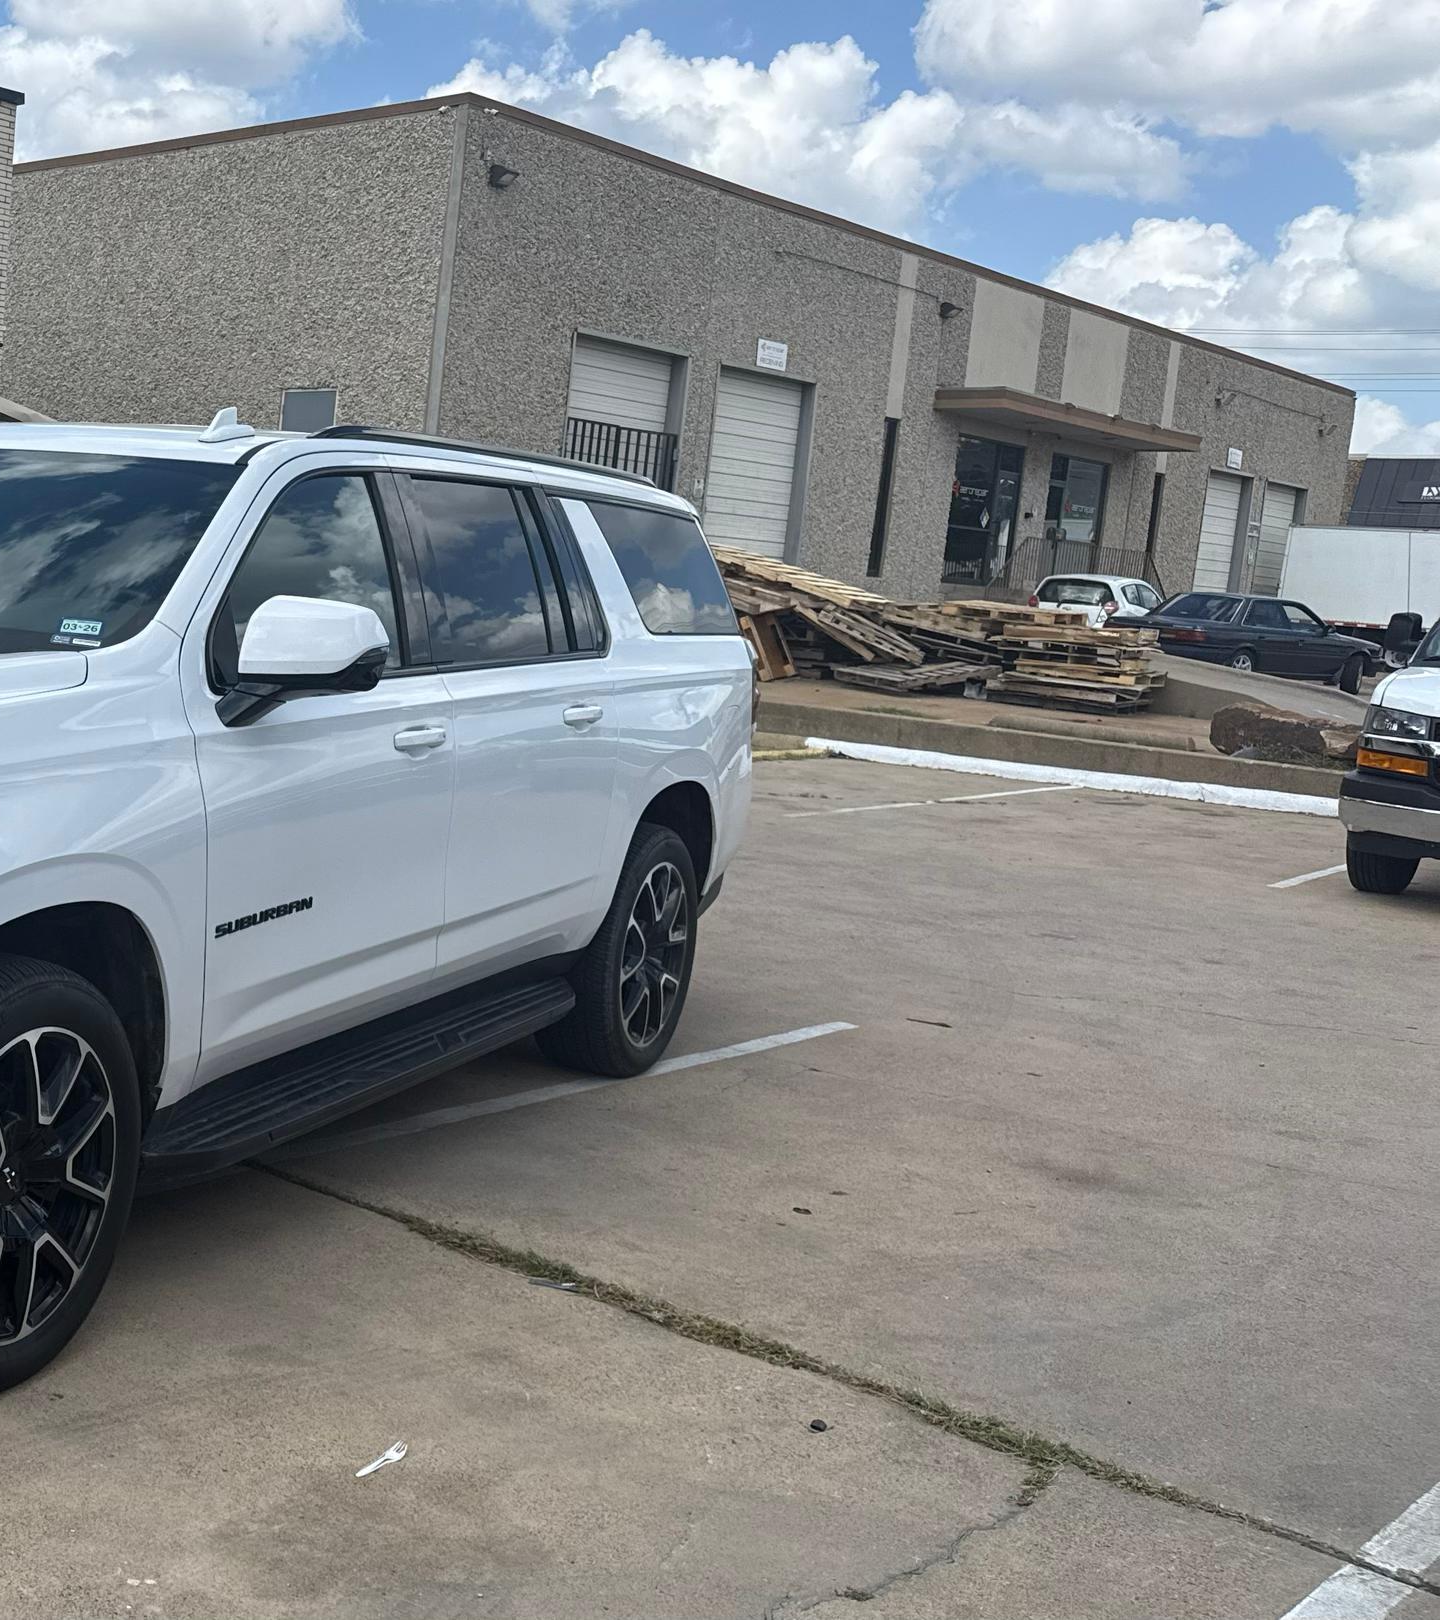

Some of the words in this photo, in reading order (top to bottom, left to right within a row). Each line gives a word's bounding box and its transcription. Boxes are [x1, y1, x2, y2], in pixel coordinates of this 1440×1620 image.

[63, 622, 77, 630] 03
[83, 624, 98, 632] 26
[215, 896, 313, 939] SUBURBAN
